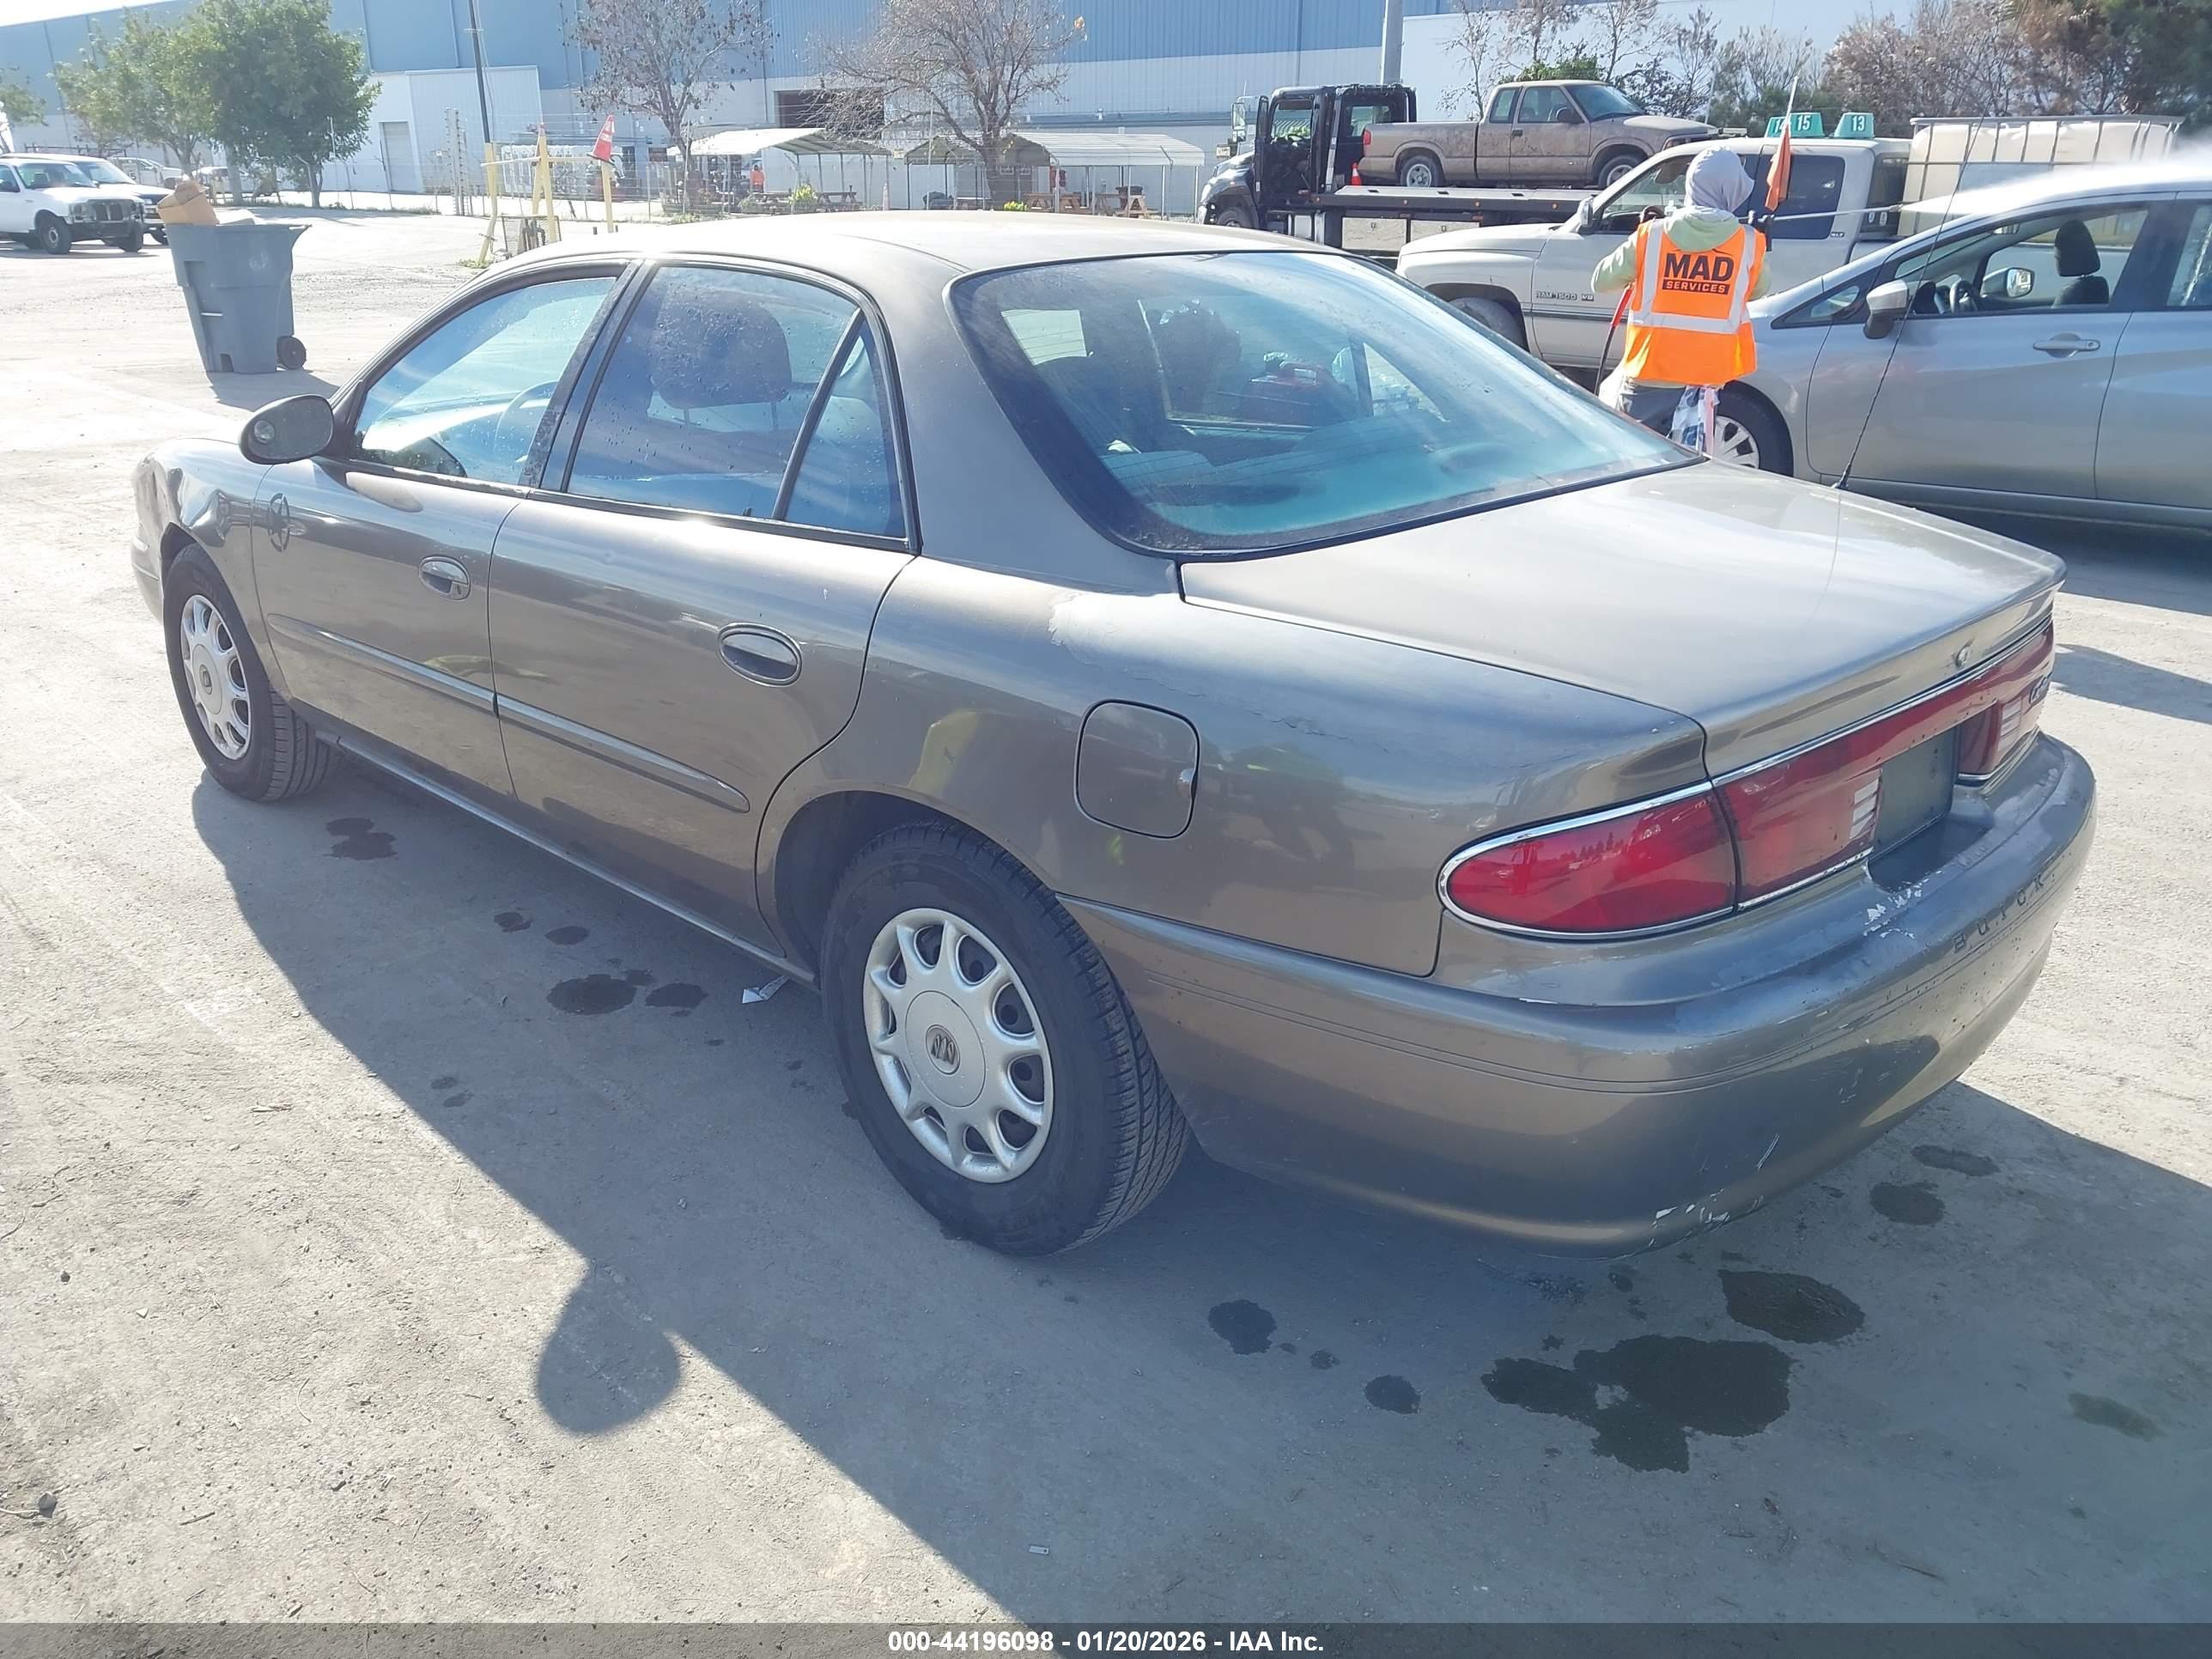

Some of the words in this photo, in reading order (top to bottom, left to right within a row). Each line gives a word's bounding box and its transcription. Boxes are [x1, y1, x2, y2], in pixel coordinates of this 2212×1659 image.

[1797, 114, 1811, 131] 15
[1851, 114, 1866, 132] 13
[1664, 252, 1735, 282] MAD
[1536, 290, 1553, 299] RAM
[1666, 280, 1727, 294] SERVICES
[1951, 873, 2045, 955] BUICK
